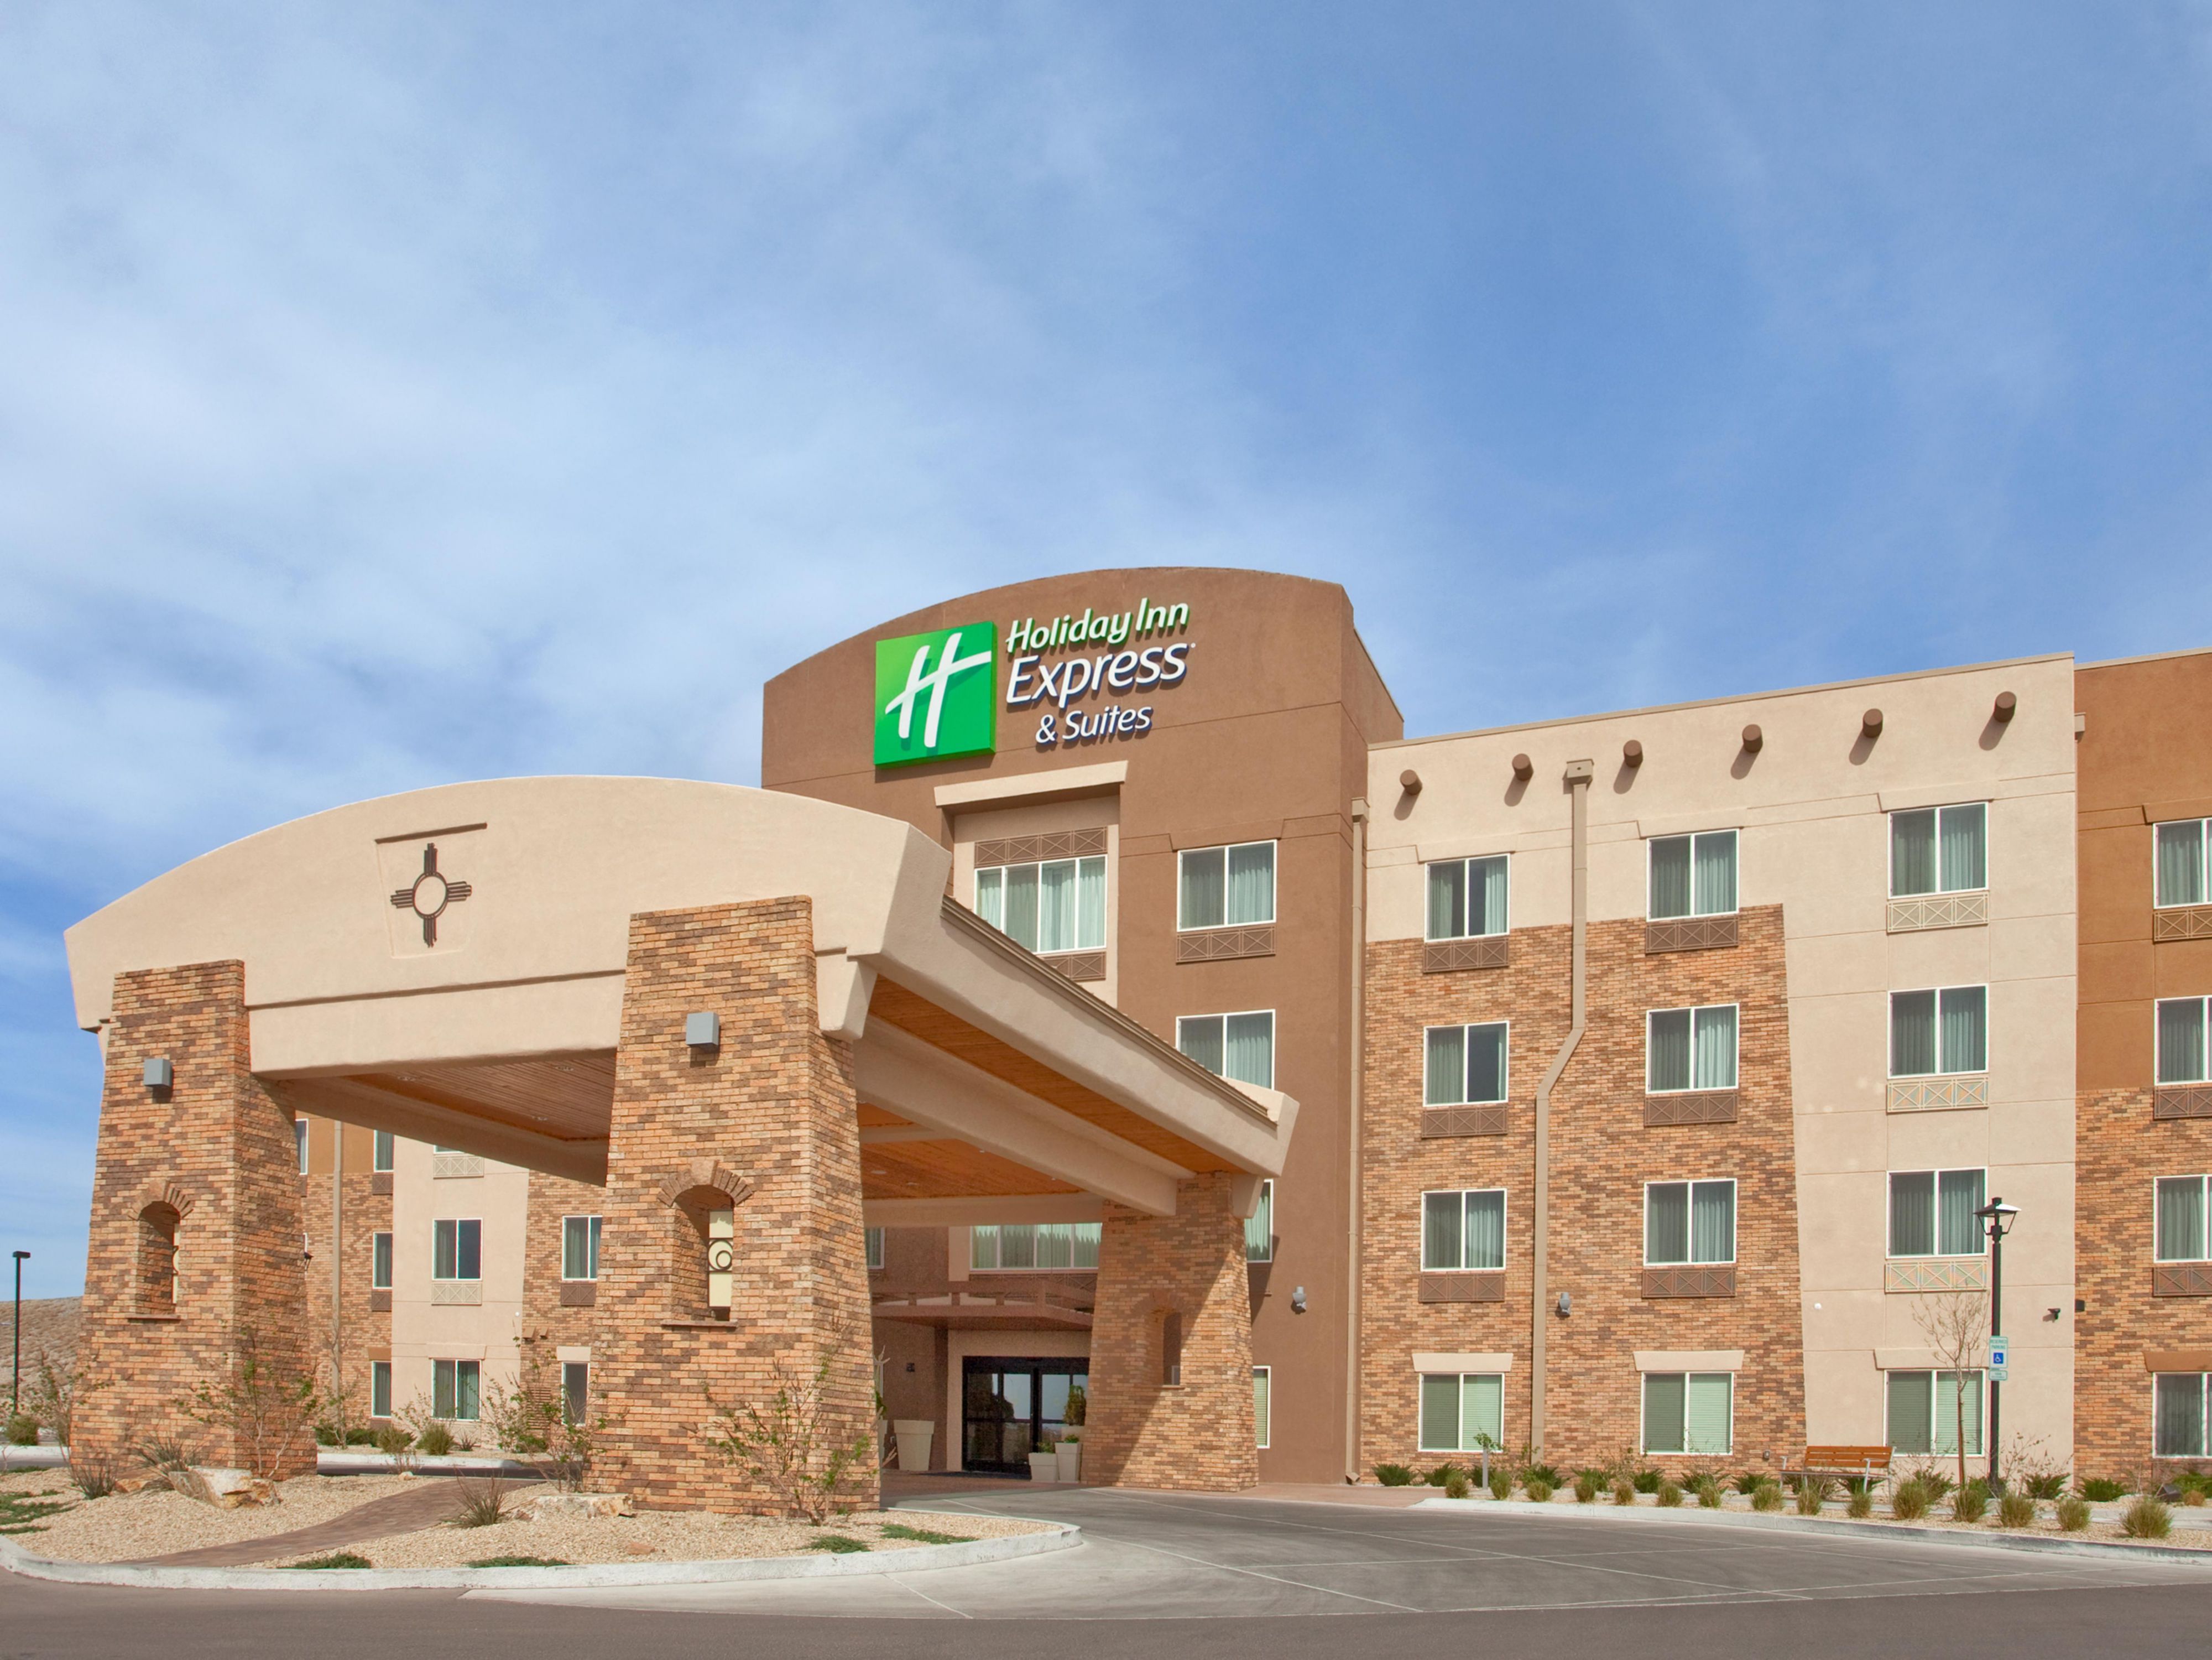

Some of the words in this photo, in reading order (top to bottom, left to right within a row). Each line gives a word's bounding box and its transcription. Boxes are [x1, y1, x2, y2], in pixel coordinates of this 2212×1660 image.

[1005, 608, 1132, 653] Holiday
[1135, 597, 1189, 632] Inn
[1006, 643, 1188, 709] Express
[1035, 714, 1056, 743] &
[1062, 705, 1152, 740] Suites
